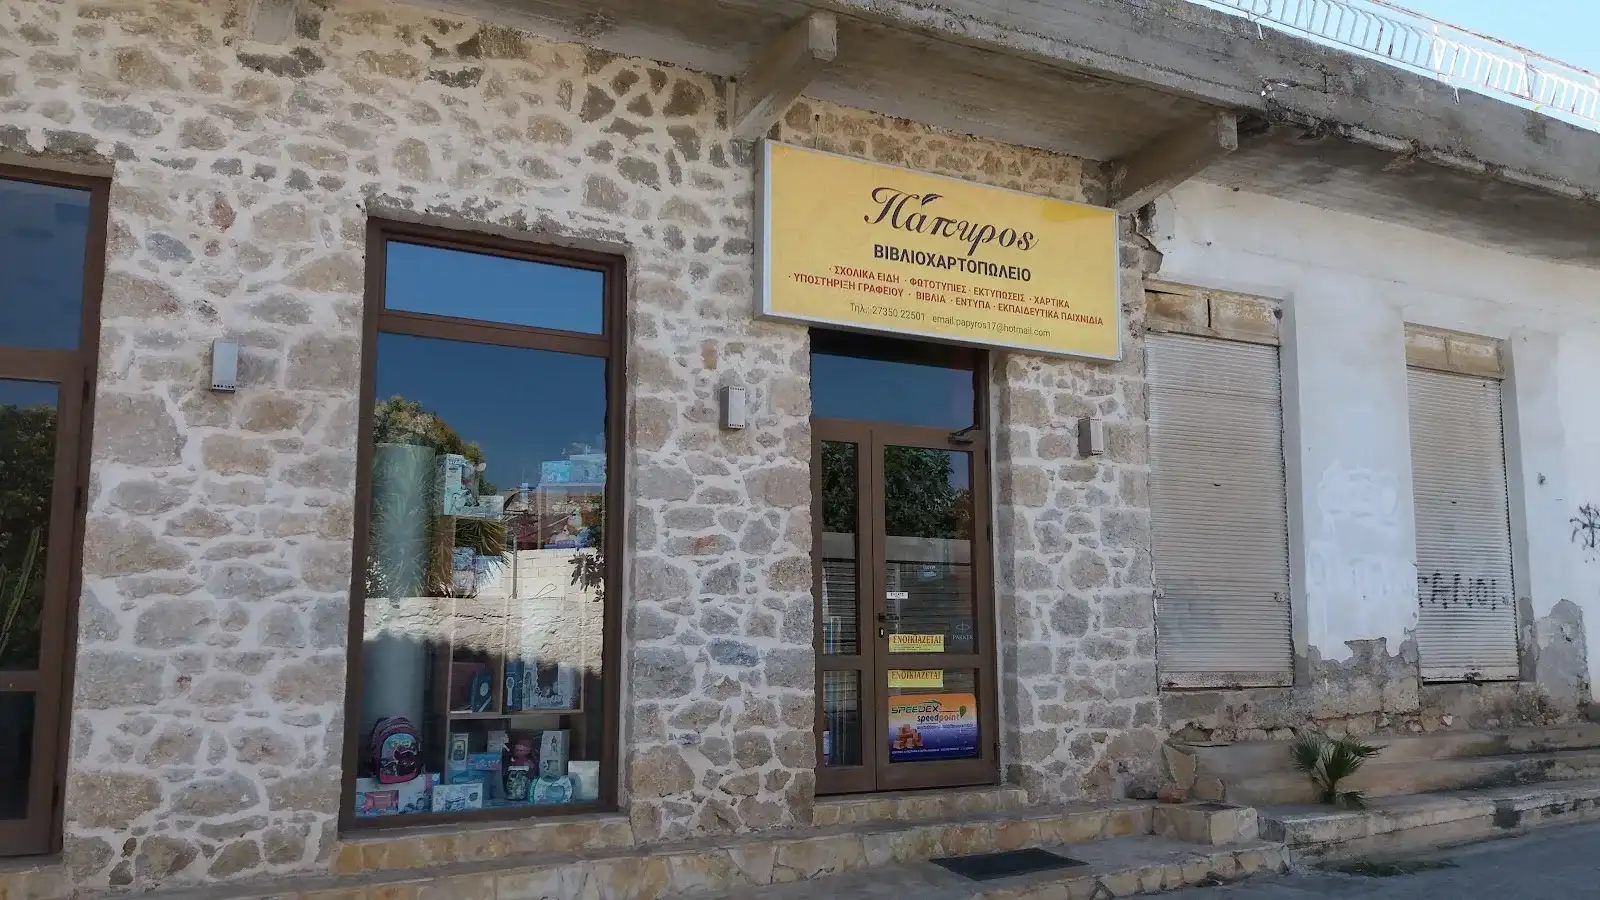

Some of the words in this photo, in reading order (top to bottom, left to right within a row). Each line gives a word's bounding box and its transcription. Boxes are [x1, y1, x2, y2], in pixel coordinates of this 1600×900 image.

[863, 187, 1040, 256] Πάπυρος
[873, 243, 1031, 282] ΒΙΒΛΙΟΧΑΡΤΟΠΩΛΕΙΟ
[793, 272, 856, 291] ΥΠΟΣΤΗΡΙΞΗ
[858, 282, 904, 298] ΓΡΑΦΕΙΟΥ
[916, 291, 946, 304] ΒΙΒΛΙΑ
[955, 297, 991, 310] ΕΝΤΥΠΑ
[998, 303, 1059, 320] ΕΚΠΑΙΔΕΥΤΙΚΑ
[1060, 311, 1104, 326] ΠΑΙΧΝΙΔΙΑ
[834, 265, 875, 280] ΣΧΟΛΙΚΑ
[877, 273, 900, 284] ΕΙΔΗ
[909, 277, 967, 294] ΦΩΤΟΤΥΠΙΕΣ
[973, 286, 1025, 302] ΕΚΤΥΠΩΣΕΙΣ
[1034, 295, 1070, 309] ΧΑΡΤΙΚΑ
[872, 305, 898, 318] 27350
[900, 309, 925, 321] 22501
[892, 635, 942, 644] ΕΝΟΙΚΙΑΖΕΤΑΙ
[891, 671, 941, 680] ΕΝΟΙΚΙΑΖΕΤΑΙ
[891, 705, 940, 714] SPEEDEX
